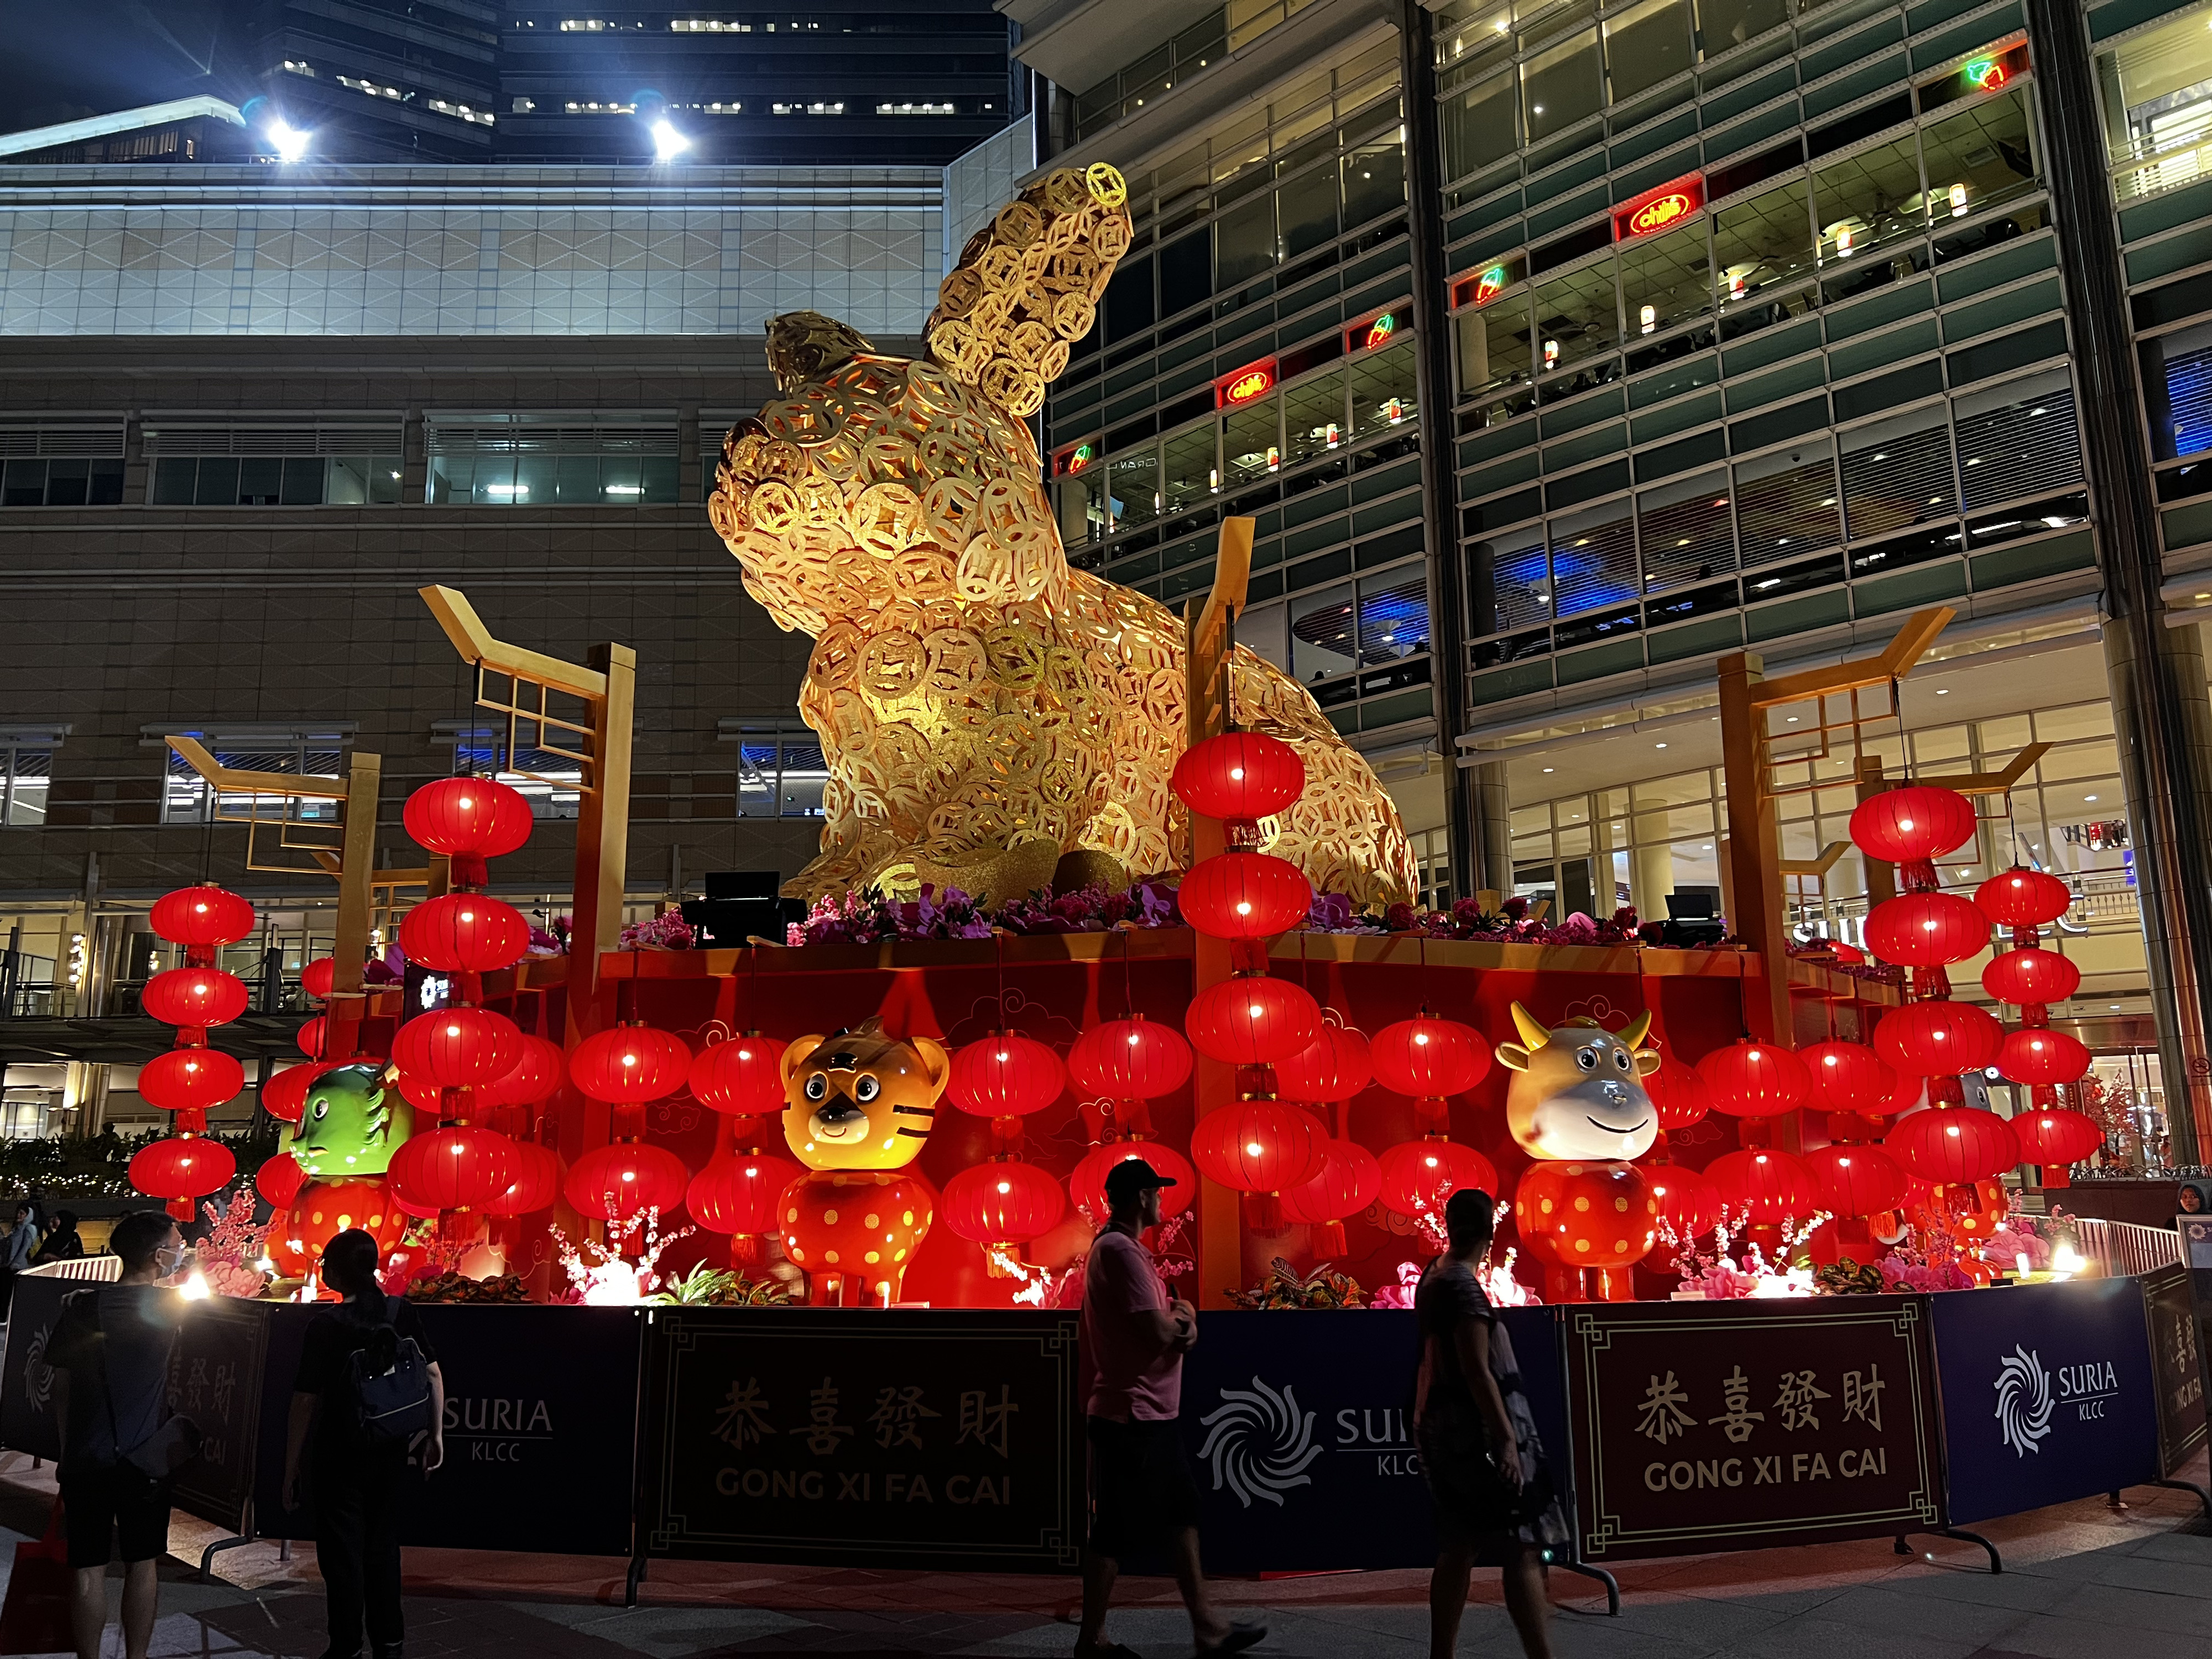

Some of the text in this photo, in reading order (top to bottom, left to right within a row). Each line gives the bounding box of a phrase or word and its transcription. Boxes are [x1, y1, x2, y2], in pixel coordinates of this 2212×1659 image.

[167, 1346, 236, 1427] 喜發財
[2059, 1361, 2118, 1397] SURIA
[444, 1396, 553, 1431] SURIA
[709, 1376, 1019, 1459] 恭喜發財
[1634, 1364, 1886, 1445] 恭喜發財
[2079, 1400, 2105, 1421] KLCC
[204, 1436, 226, 1466] CAI
[472, 1441, 520, 1462] KLCC
[1378, 1454, 1420, 1476] KLC
[1644, 1447, 1886, 1491] GONG XI FA CAI
[716, 1467, 1010, 1505] GONG XI FA CAI
